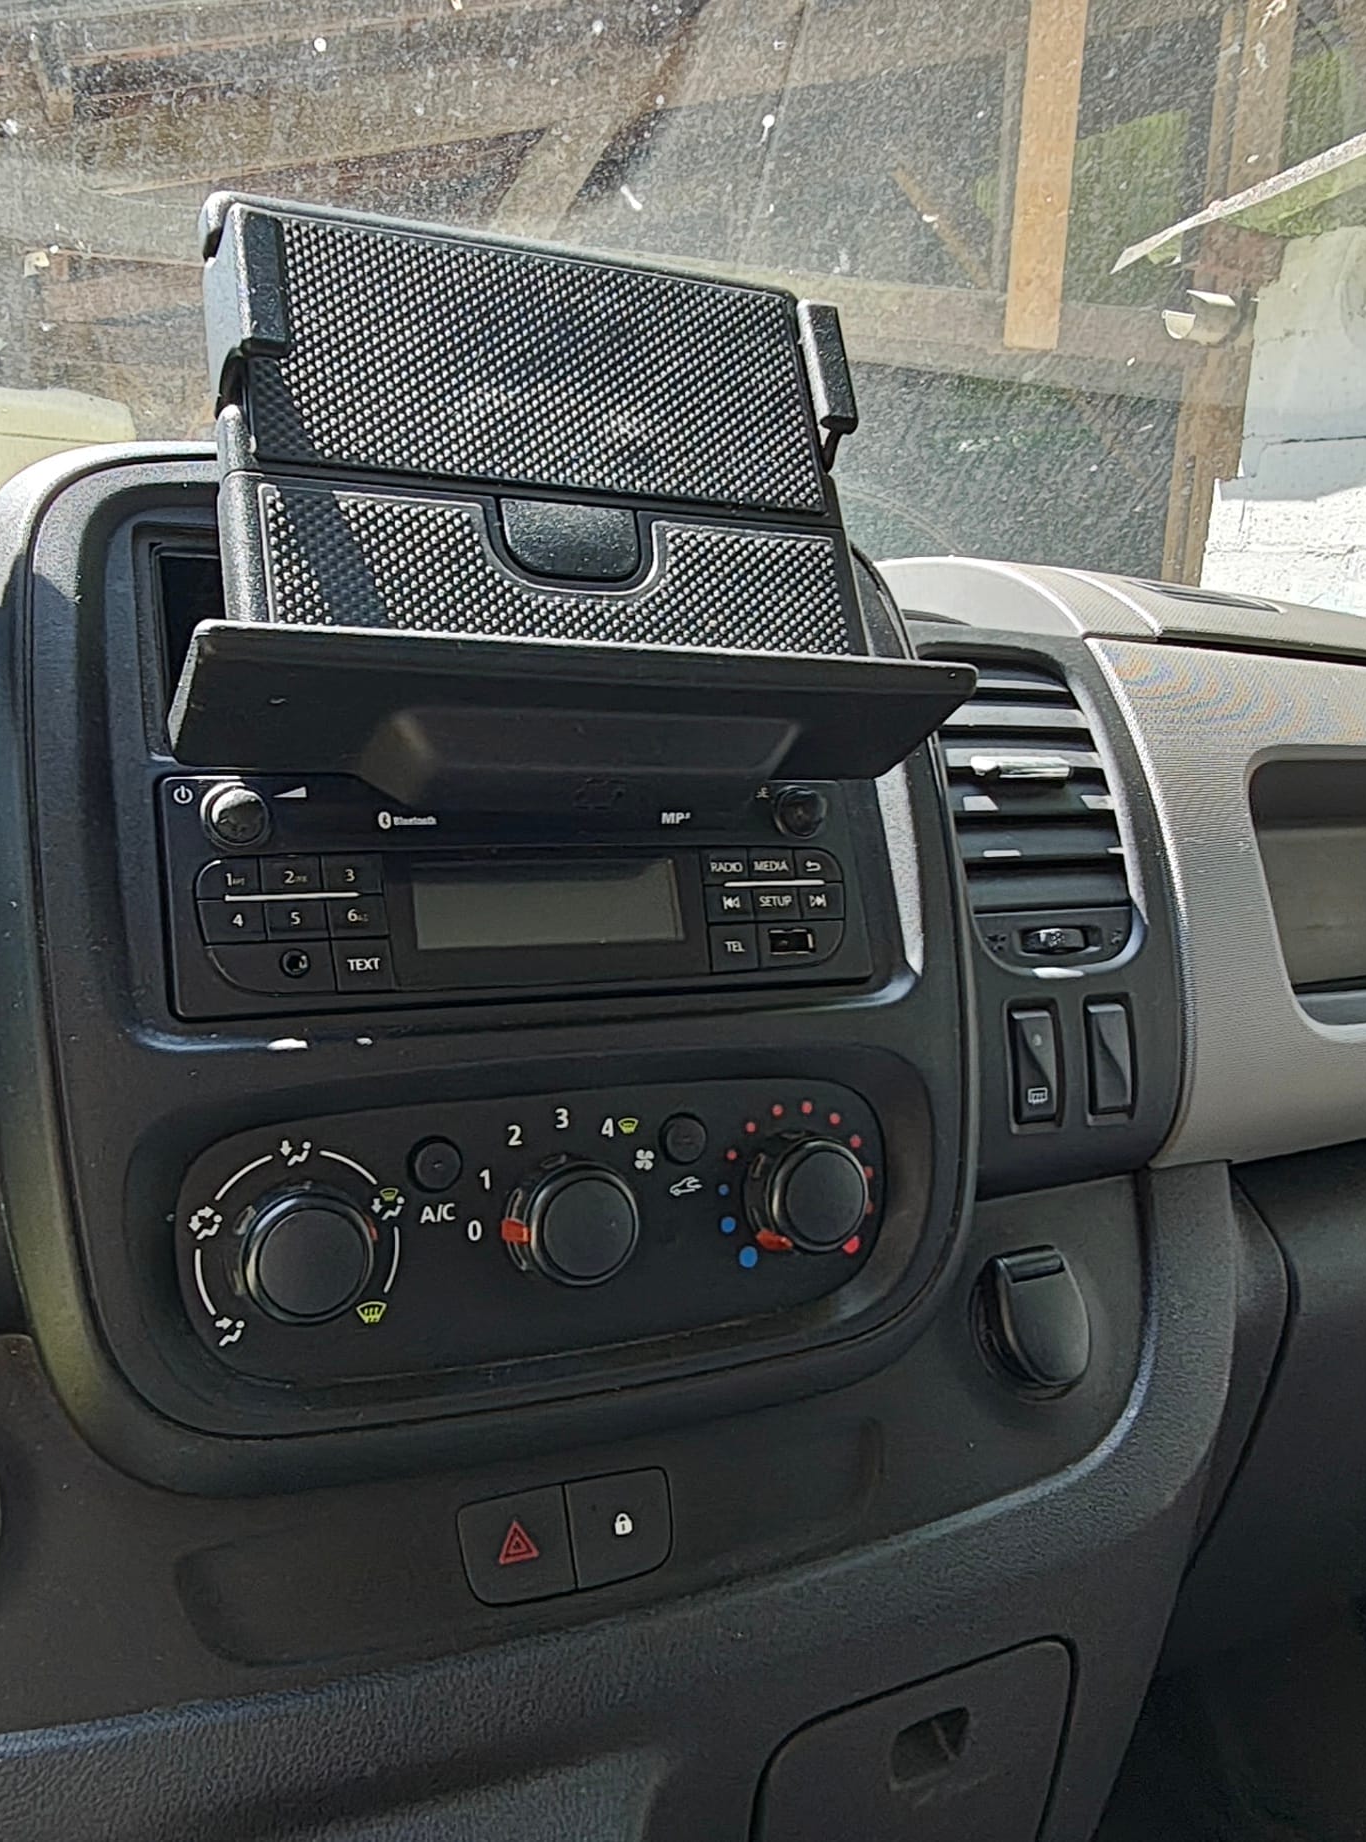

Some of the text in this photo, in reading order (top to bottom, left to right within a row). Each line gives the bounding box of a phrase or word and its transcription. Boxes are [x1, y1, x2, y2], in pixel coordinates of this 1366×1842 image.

[710, 861, 743, 873] RADIO
[753, 860, 789, 872] MEDIA
[225, 872, 233, 886] 1
[283, 870, 295, 884] 2
[345, 868, 356, 882] 3
[759, 895, 793, 907] SETUP
[232, 913, 244, 927] 4
[290, 911, 301, 927] 5
[347, 908, 357, 922] 6
[724, 940, 746, 953] TEL
[347, 956, 381, 972] TEXT
[554, 1107, 570, 1129] 3
[601, 1117, 615, 1138] 4
[507, 1124, 523, 1146] 2
[479, 1168, 491, 1190] 1
[420, 1202, 456, 1224] A/C
[467, 1220, 483, 1242] 0
